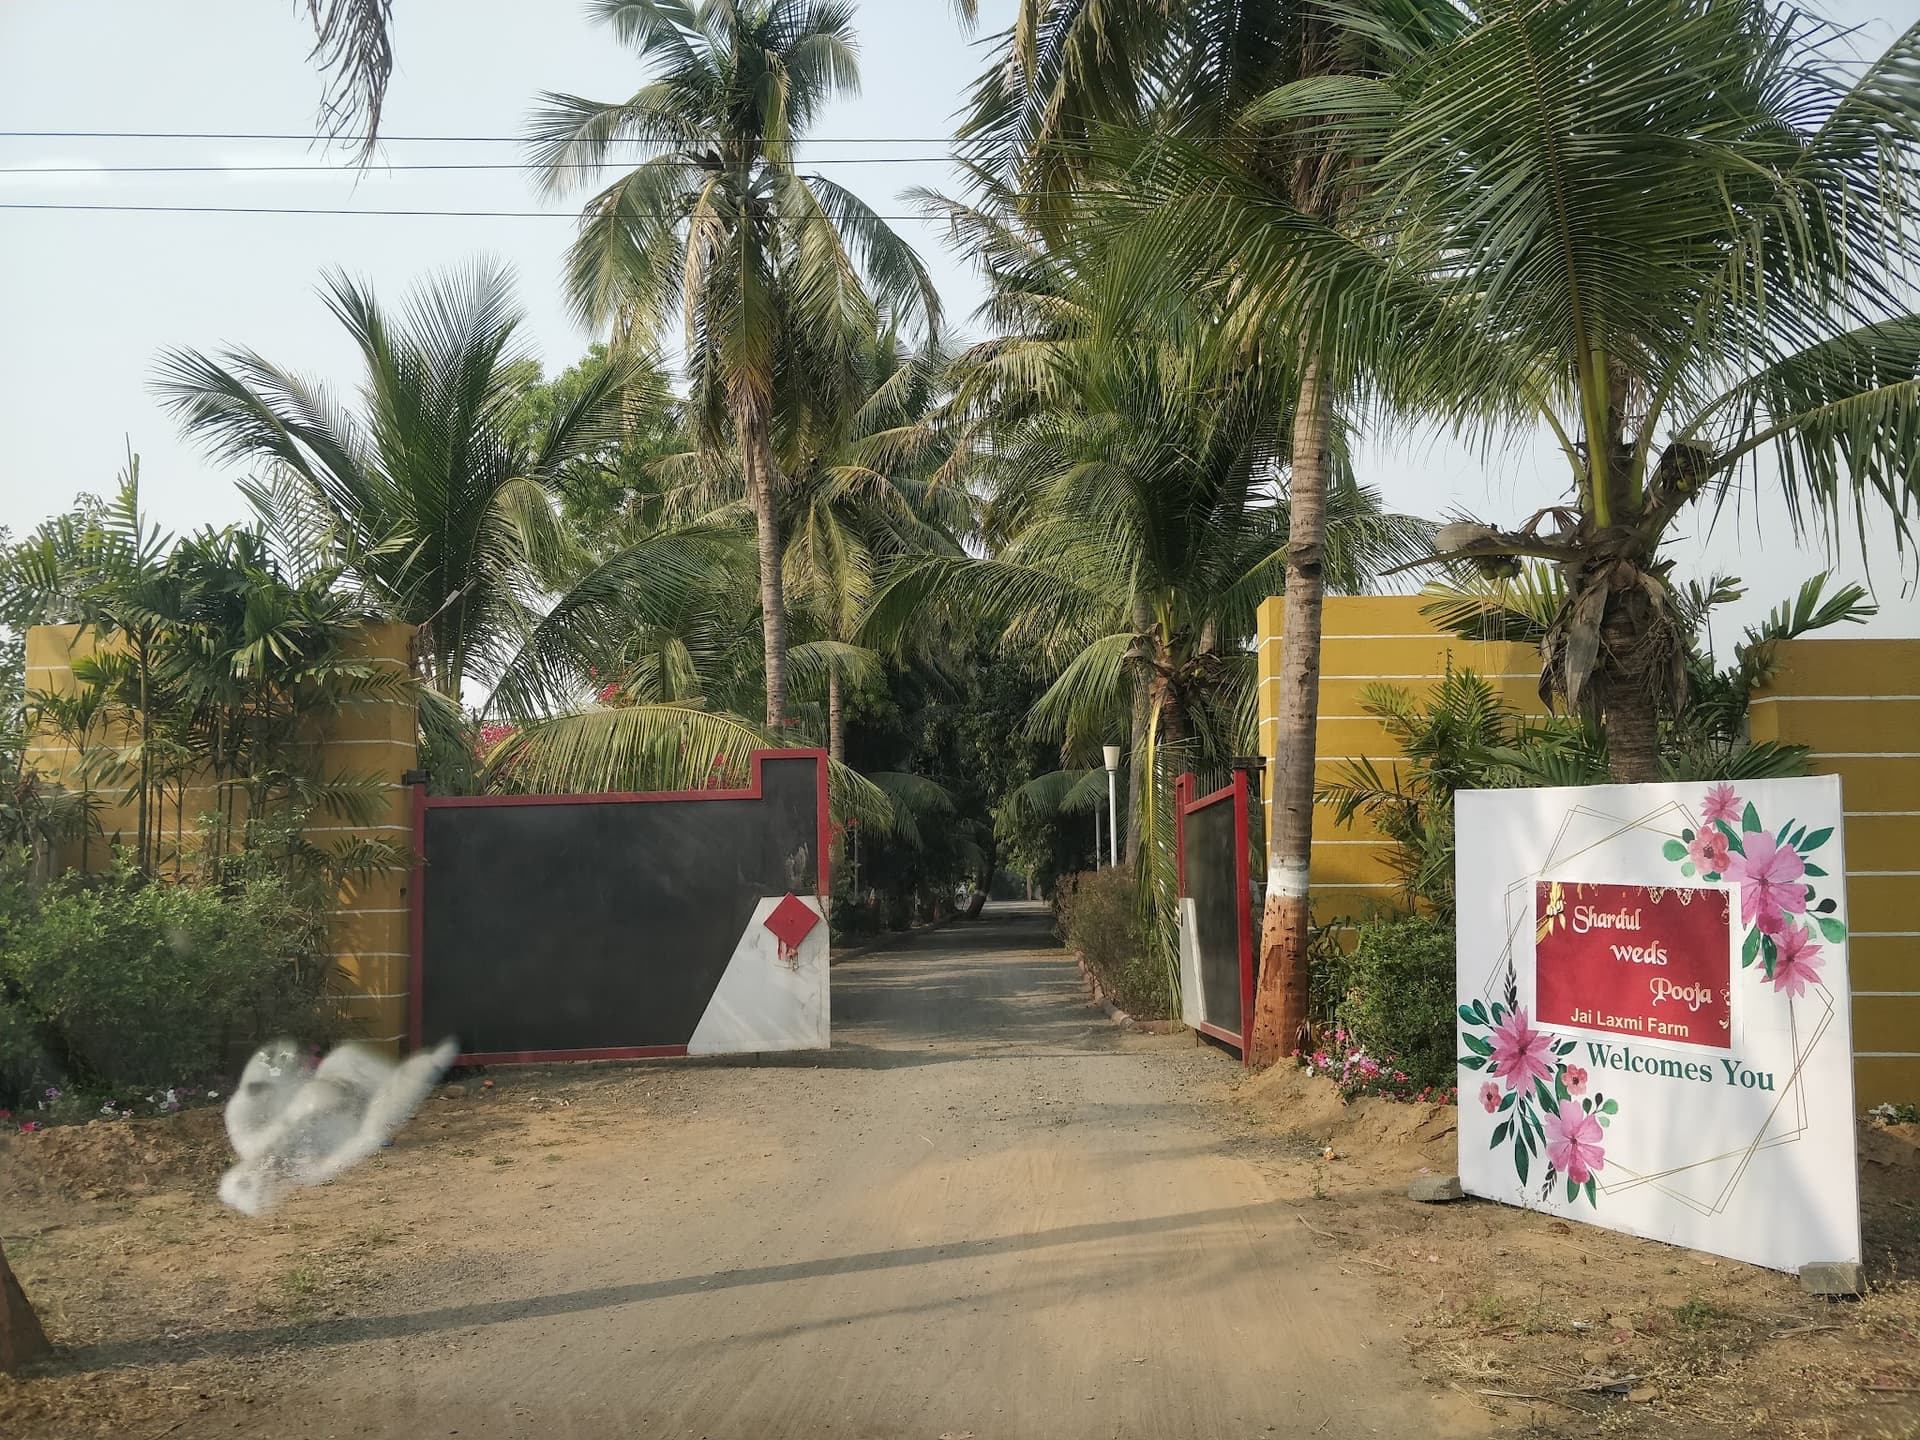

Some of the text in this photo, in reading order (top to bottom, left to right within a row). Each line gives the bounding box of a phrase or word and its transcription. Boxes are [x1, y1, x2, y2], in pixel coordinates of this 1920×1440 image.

[1572, 905, 1641, 933] Shardul
[1609, 941, 1668, 966] weds
[1649, 978, 1713, 1012] Pooja
[1570, 1008, 1689, 1037] Jai Laxmi Farm
[1586, 1042, 1775, 1092] Welcomes You
